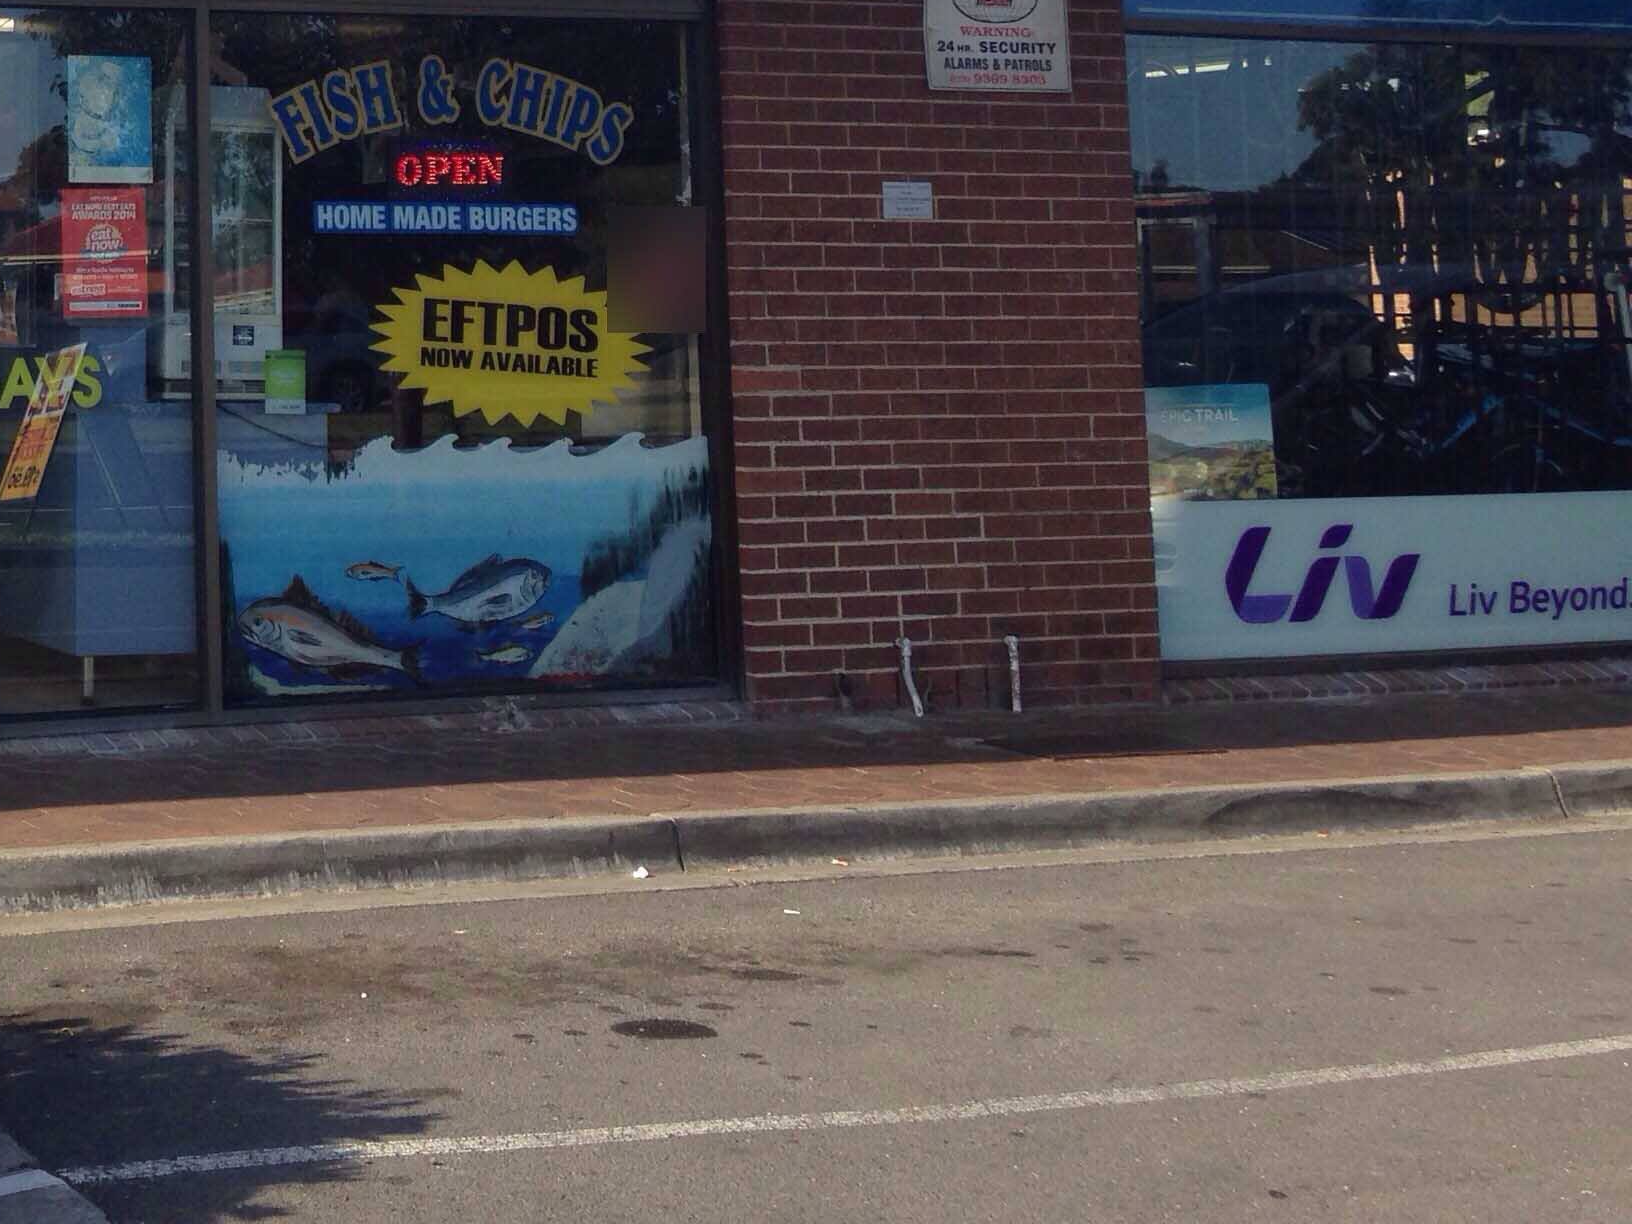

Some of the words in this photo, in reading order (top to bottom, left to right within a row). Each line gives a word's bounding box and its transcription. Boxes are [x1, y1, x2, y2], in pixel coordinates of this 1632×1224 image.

[959, 26, 1033, 38] WARNING
[936, 40, 955, 53] 24
[979, 41, 1057, 55] SECURITY
[944, 57, 989, 71] ALARMS
[1004, 59, 1052, 73] PATROLS
[272, 59, 403, 164] FISH
[417, 54, 460, 125] &
[475, 57, 634, 166] CHIPS
[394, 152, 505, 187] OPEN
[316, 204, 386, 231] HOME
[393, 204, 462, 232] MADE
[469, 205, 578, 233] BURGERS
[91, 228, 112, 241] eat
[91, 239, 120, 251] now
[422, 297, 599, 353] EFTPOS
[420, 346, 474, 370] NOW
[480, 350, 599, 378] AVAILABLE
[1195, 407, 1240, 424] TRAIL
[1225, 523, 1421, 624] Liv
[1449, 583, 1498, 617] Liv
